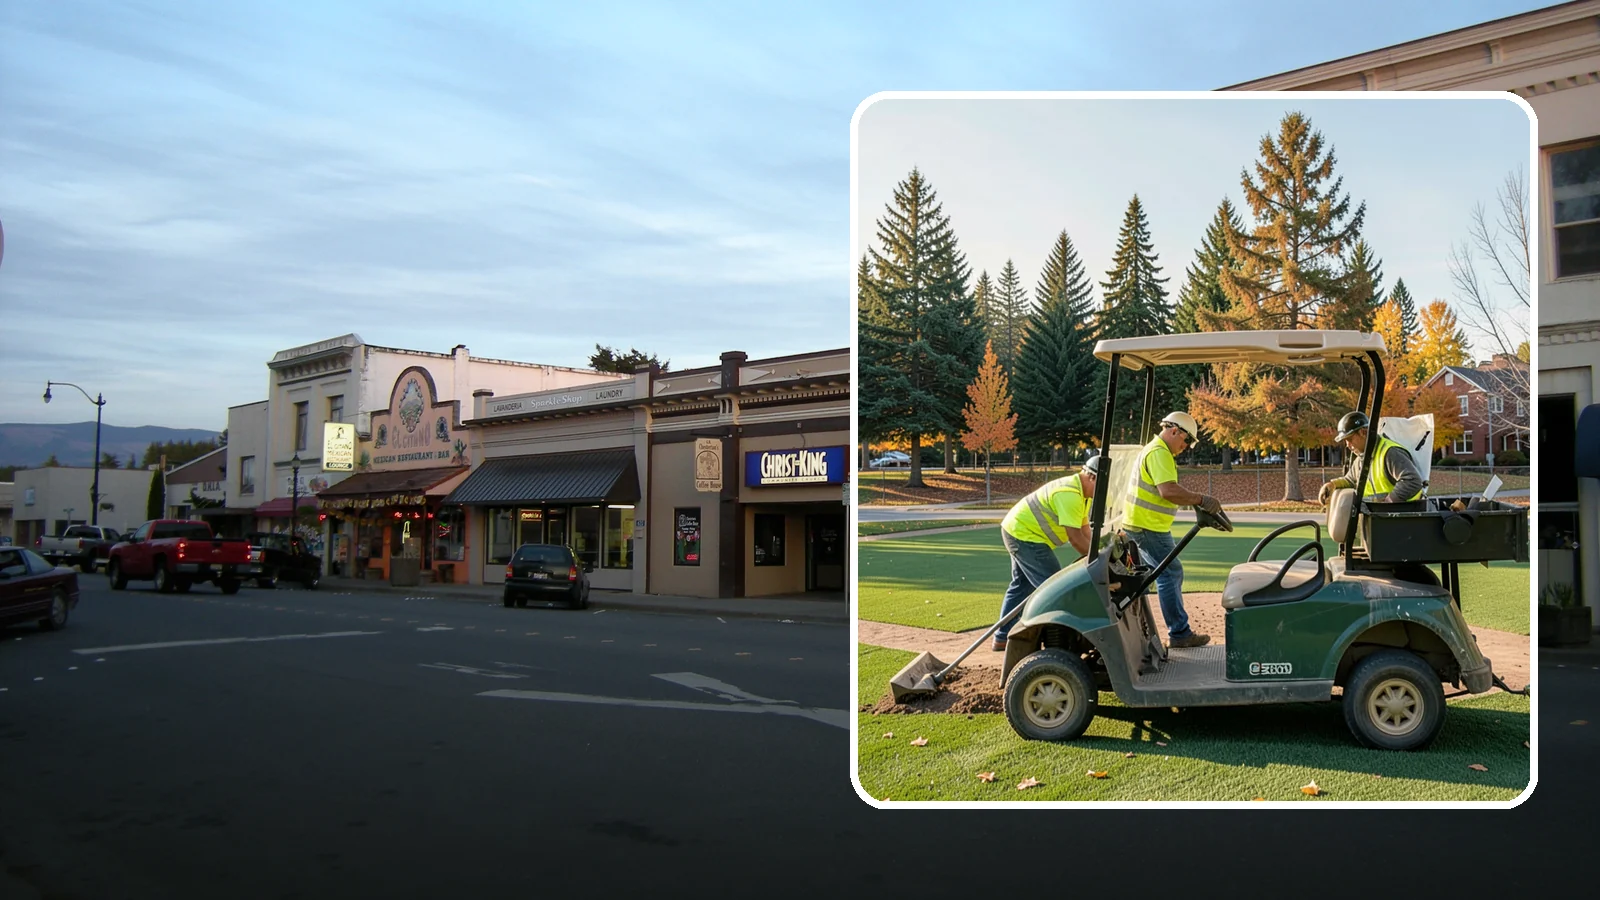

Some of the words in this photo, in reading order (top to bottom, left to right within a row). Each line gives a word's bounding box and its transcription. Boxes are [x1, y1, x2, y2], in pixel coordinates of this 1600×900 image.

[493, 402, 523, 412] LAVANDERIA
[530, 398, 561, 410] Sparkle
[562, 394, 582, 406] Shop
[595, 388, 624, 399] LAUNDRY
[373, 454, 397, 464] MEXICAN
[397, 450, 434, 462] RESTAURANT
[438, 450, 450, 459] BAR
[761, 452, 798, 477] CHRIST
[799, 449, 827, 476] KING
